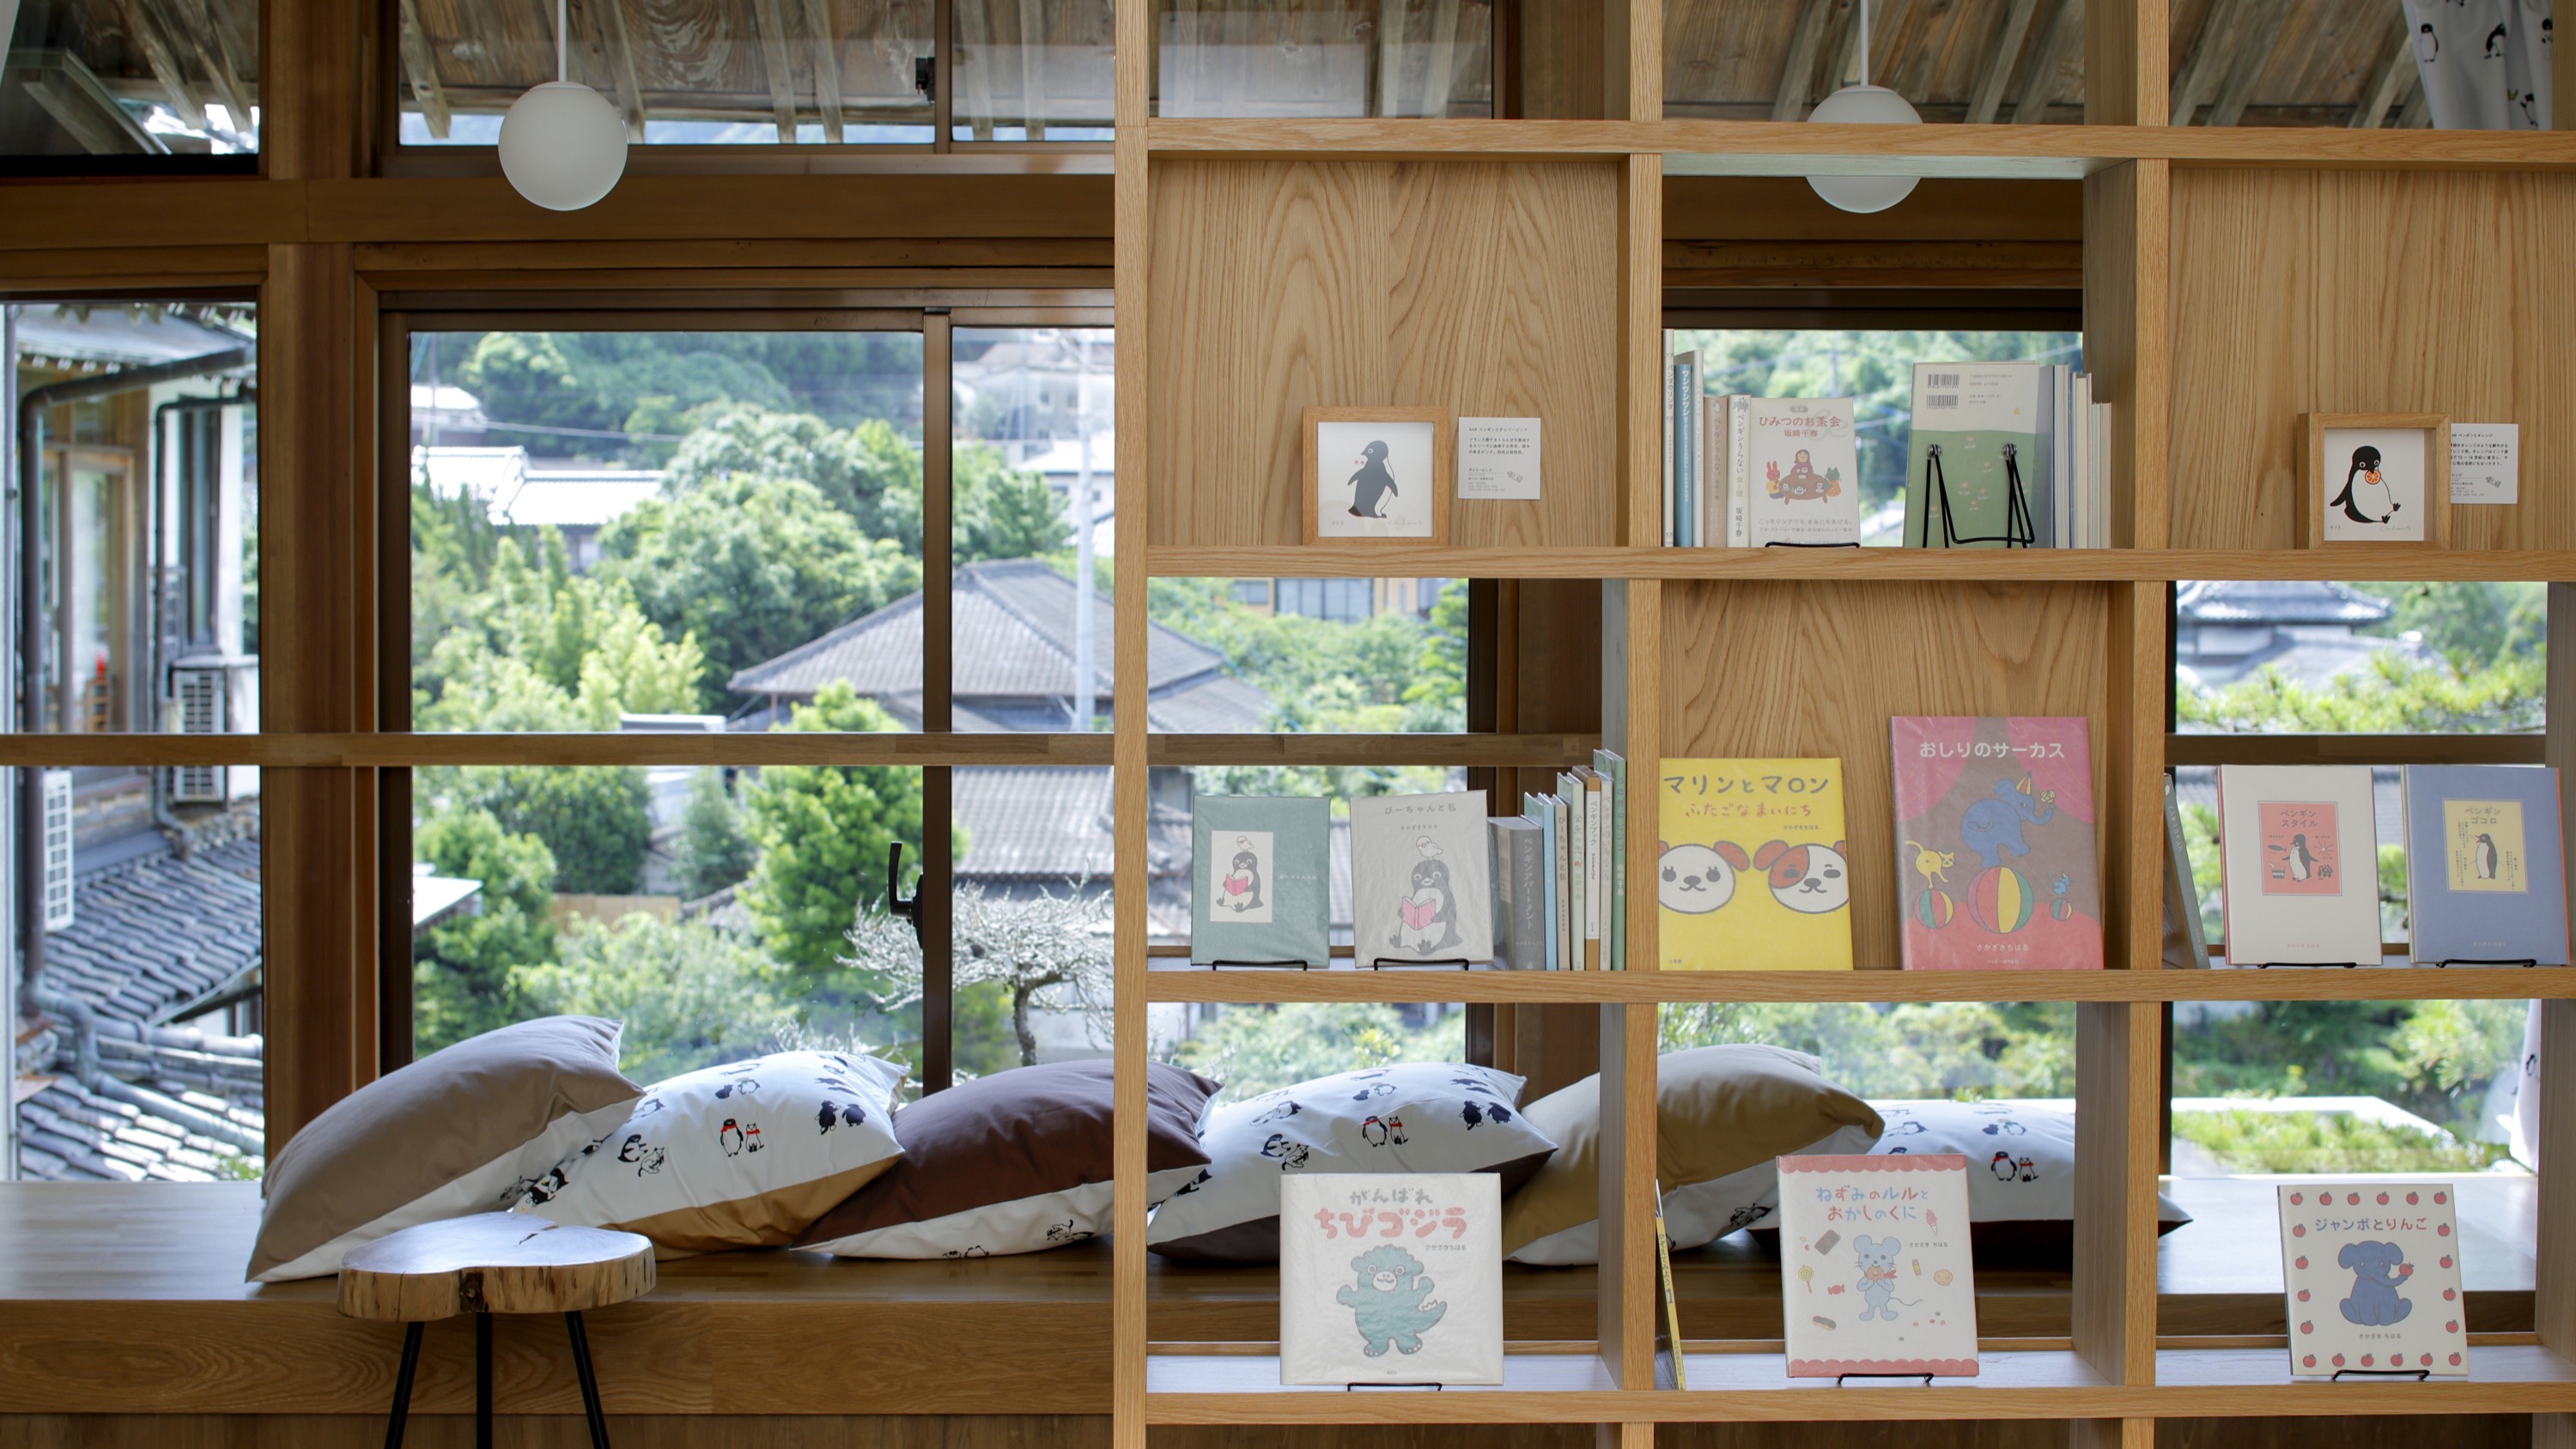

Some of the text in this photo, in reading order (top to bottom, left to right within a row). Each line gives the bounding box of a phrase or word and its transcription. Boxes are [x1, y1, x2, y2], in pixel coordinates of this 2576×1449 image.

[1759, 415, 1842, 427] ひみつのお茶会
[1783, 429, 1818, 438] 坂崎千春
[1736, 414, 1745, 474] ペンギンうらない
[1919, 741, 2066, 760] おしりのサーカス
[1663, 773, 1829, 796] マリンとマロン
[1384, 803, 1457, 815] ぴーちゃんと私
[1685, 801, 1812, 819] ふたごなまいにち
[2281, 809, 2317, 818] ペンギン
[2464, 807, 2500, 815] ペンギン
[2281, 819, 2318, 828] スタイル
[1523, 837, 1534, 930] ペンギンアパートメント
[1977, 943, 2029, 952] さかざきちはる
[1349, 1188, 1433, 1205] がんばれ
[1816, 1184, 1929, 1201] ねずみのルルと
[1827, 1204, 1917, 1222] おかしのくに
[1314, 1206, 1467, 1240] ちびゴジラ
[2314, 1216, 2427, 1232] ジャンボとりんご
